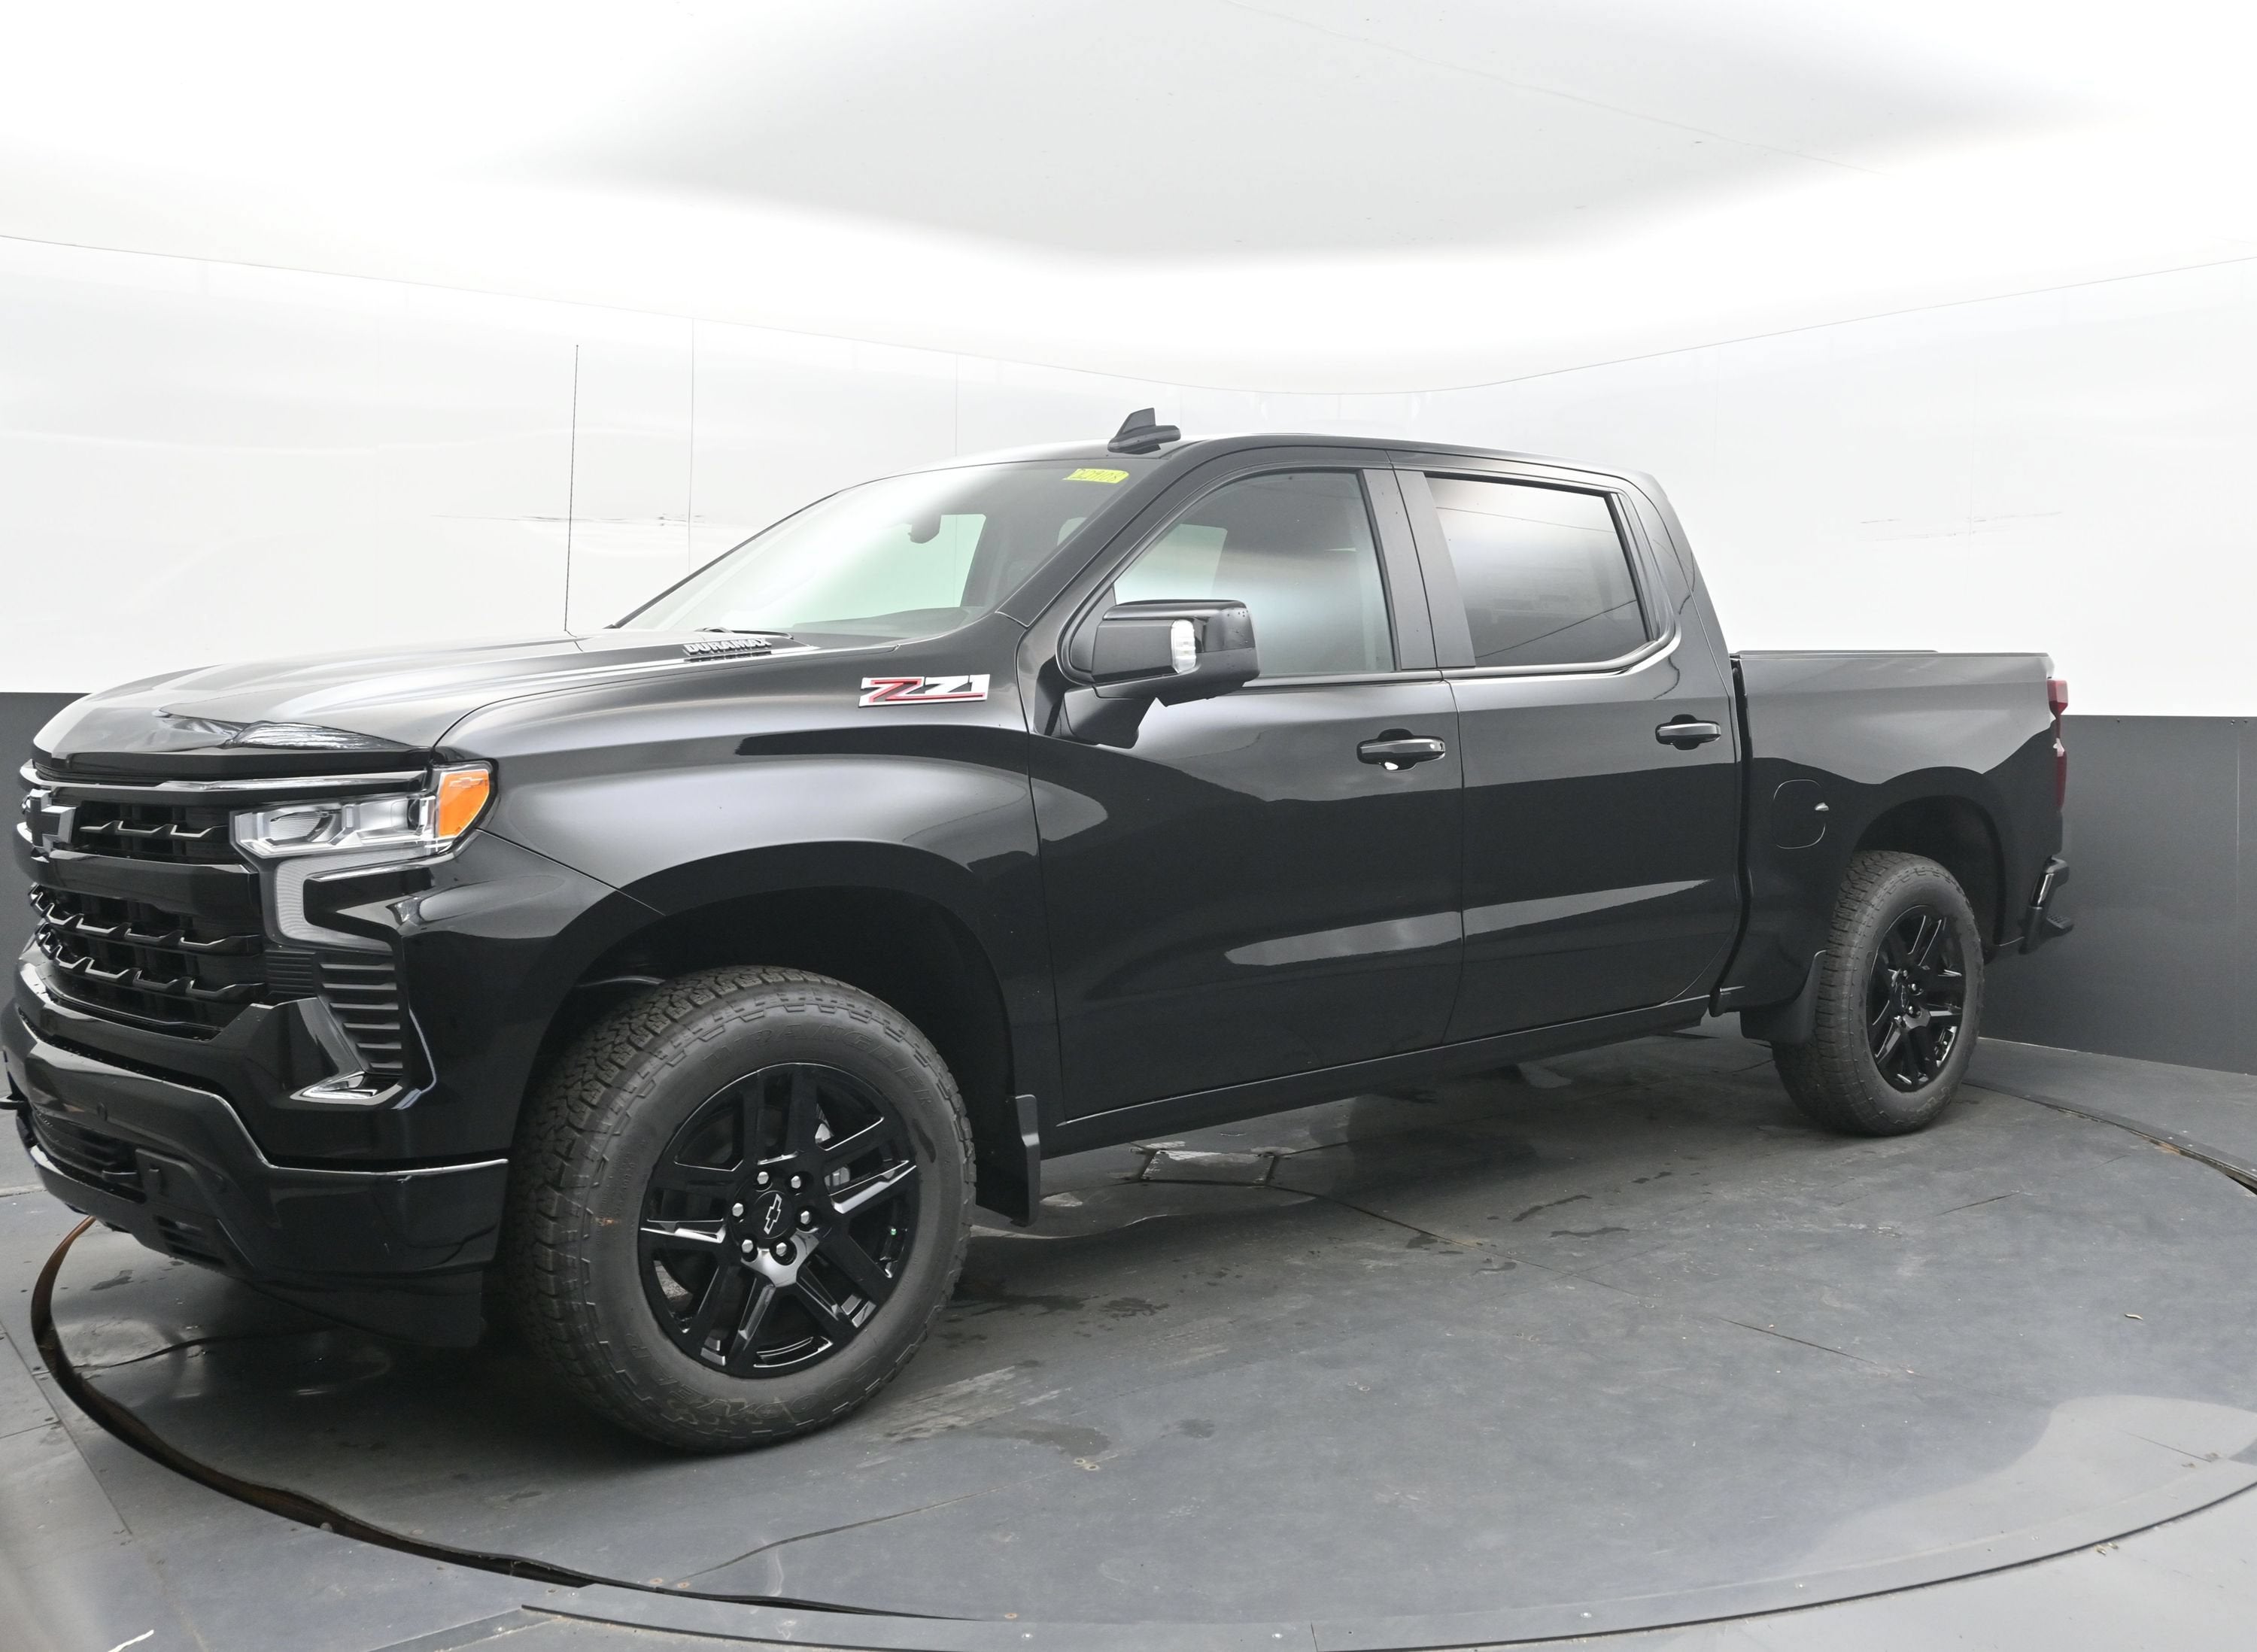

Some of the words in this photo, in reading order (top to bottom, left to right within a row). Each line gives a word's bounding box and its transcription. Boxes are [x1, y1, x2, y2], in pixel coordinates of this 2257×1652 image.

[683, 638, 772, 655] DURAMAX
[858, 674, 990, 707] Z71
[702, 1022, 935, 1116] WRANGLER
